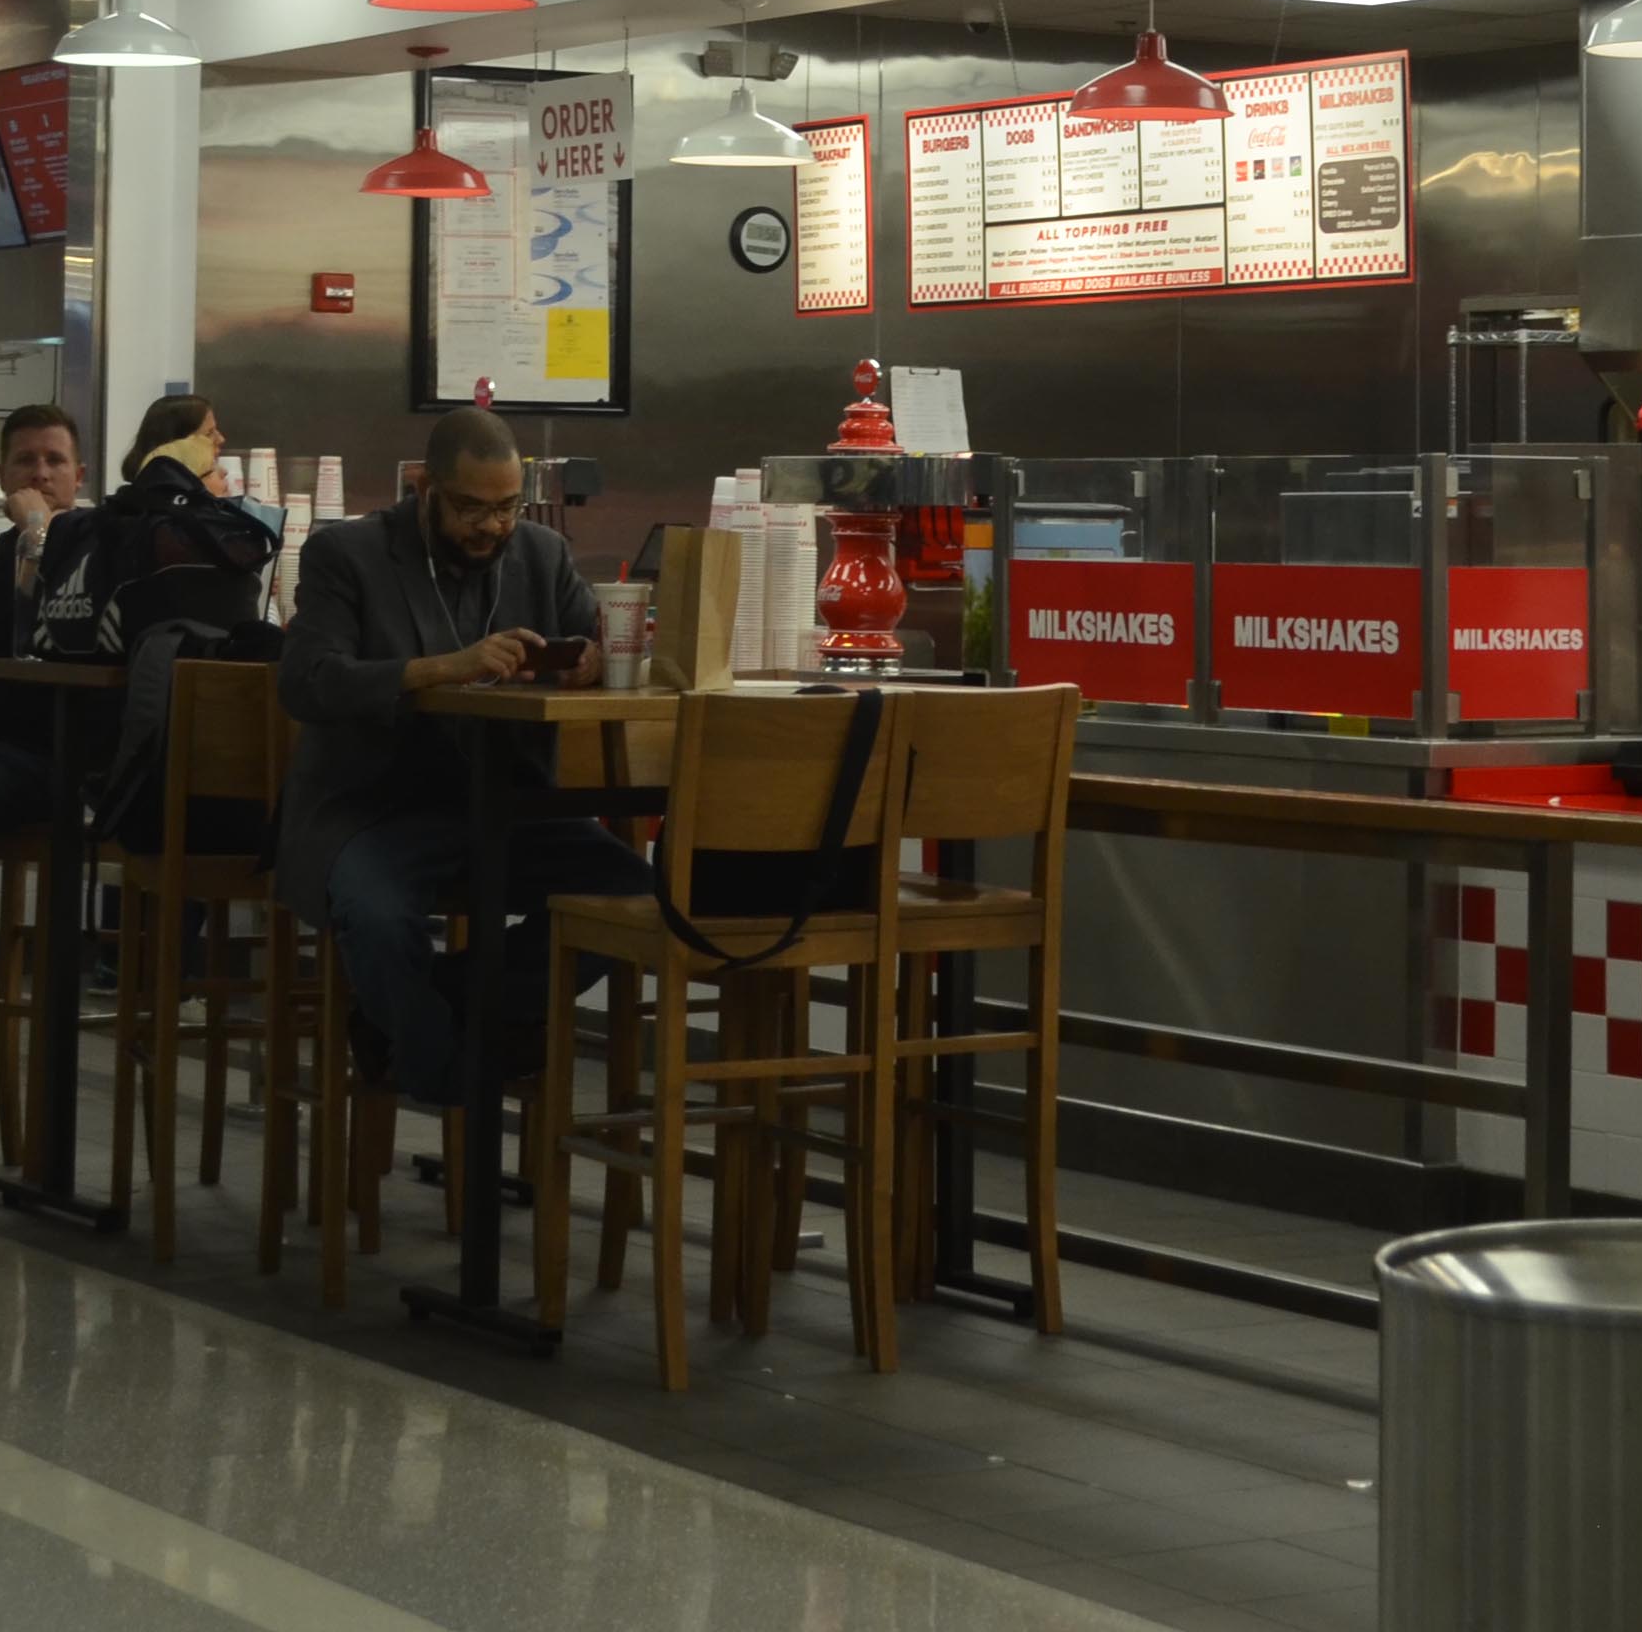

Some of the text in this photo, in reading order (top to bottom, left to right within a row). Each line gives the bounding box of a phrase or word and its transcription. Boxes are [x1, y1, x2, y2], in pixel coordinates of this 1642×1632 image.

[1245, 99, 1289, 118] DRINKS
[1319, 87, 1394, 110] MILKSHAKES
[541, 98, 615, 140] ORDER
[1063, 120, 1135, 139] SANDWICHES
[923, 135, 969, 154] BURGERS
[1006, 129, 1035, 145] DOGS
[556, 143, 605, 178] HERE
[1038, 219, 1169, 241] ALL TOPPINGS FREE
[999, 270, 1211, 295] ALL BURGERS AND DOGS AVAILABLE BUNLESS
[46, 593, 94, 620] adidas
[1028, 608, 1175, 646] MILKSHAKES
[1233, 615, 1400, 655] MILKSHAKES
[1453, 628, 1584, 651] MILKSHAKES
